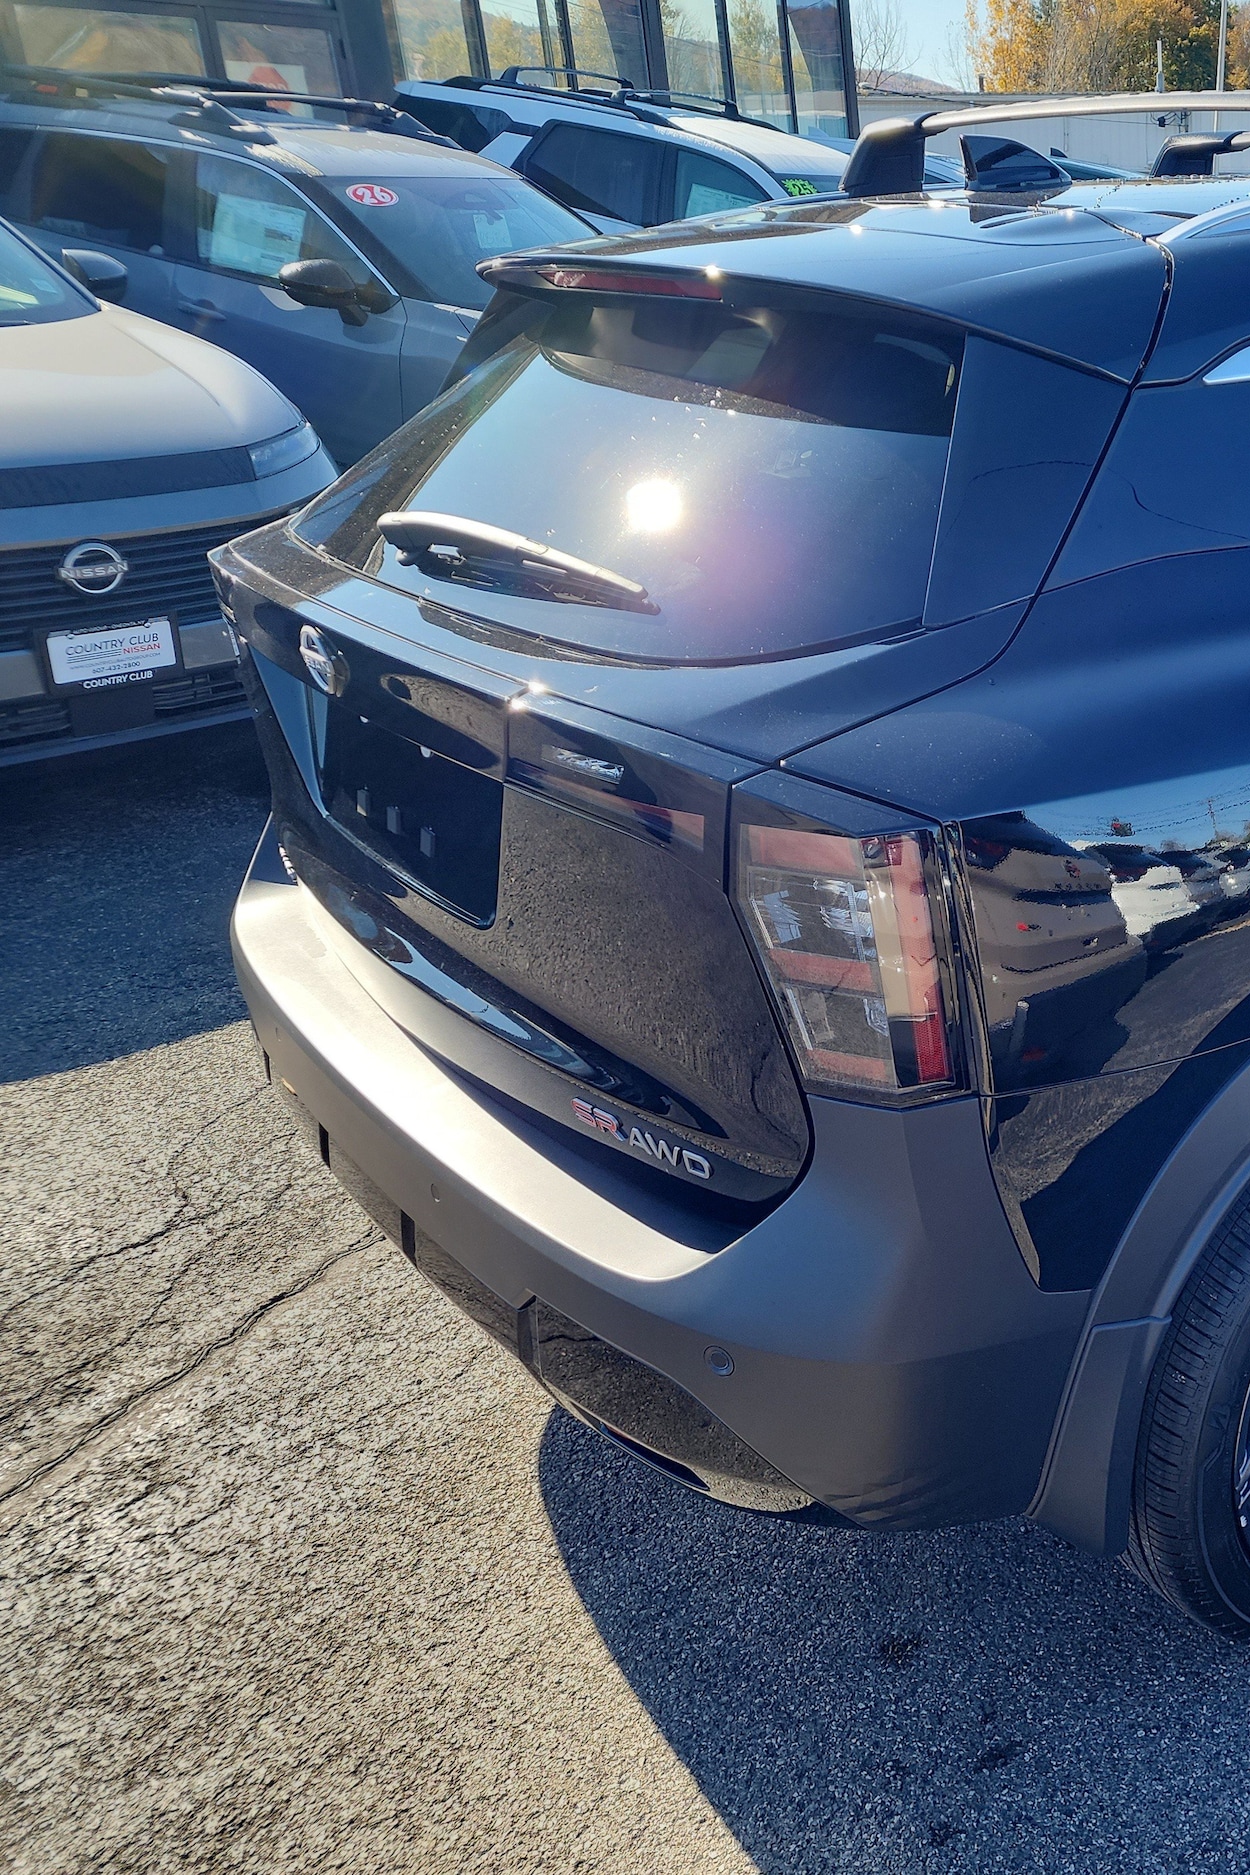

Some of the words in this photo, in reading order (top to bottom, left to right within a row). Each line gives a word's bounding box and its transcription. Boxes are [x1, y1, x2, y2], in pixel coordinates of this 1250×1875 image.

[355, 186, 392, 204] 26
[60, 561, 128, 578] NISSAN
[65, 637, 125, 656] COUNTRY
[129, 632, 159, 646] CLUB
[122, 643, 161, 655] NISSAN
[92, 661, 141, 674] 607-432-2800
[83, 674, 128, 689] COUNTRY
[128, 670, 154, 681] CLUB
[571, 1097, 626, 1142] SR
[629, 1127, 711, 1180] AWD
